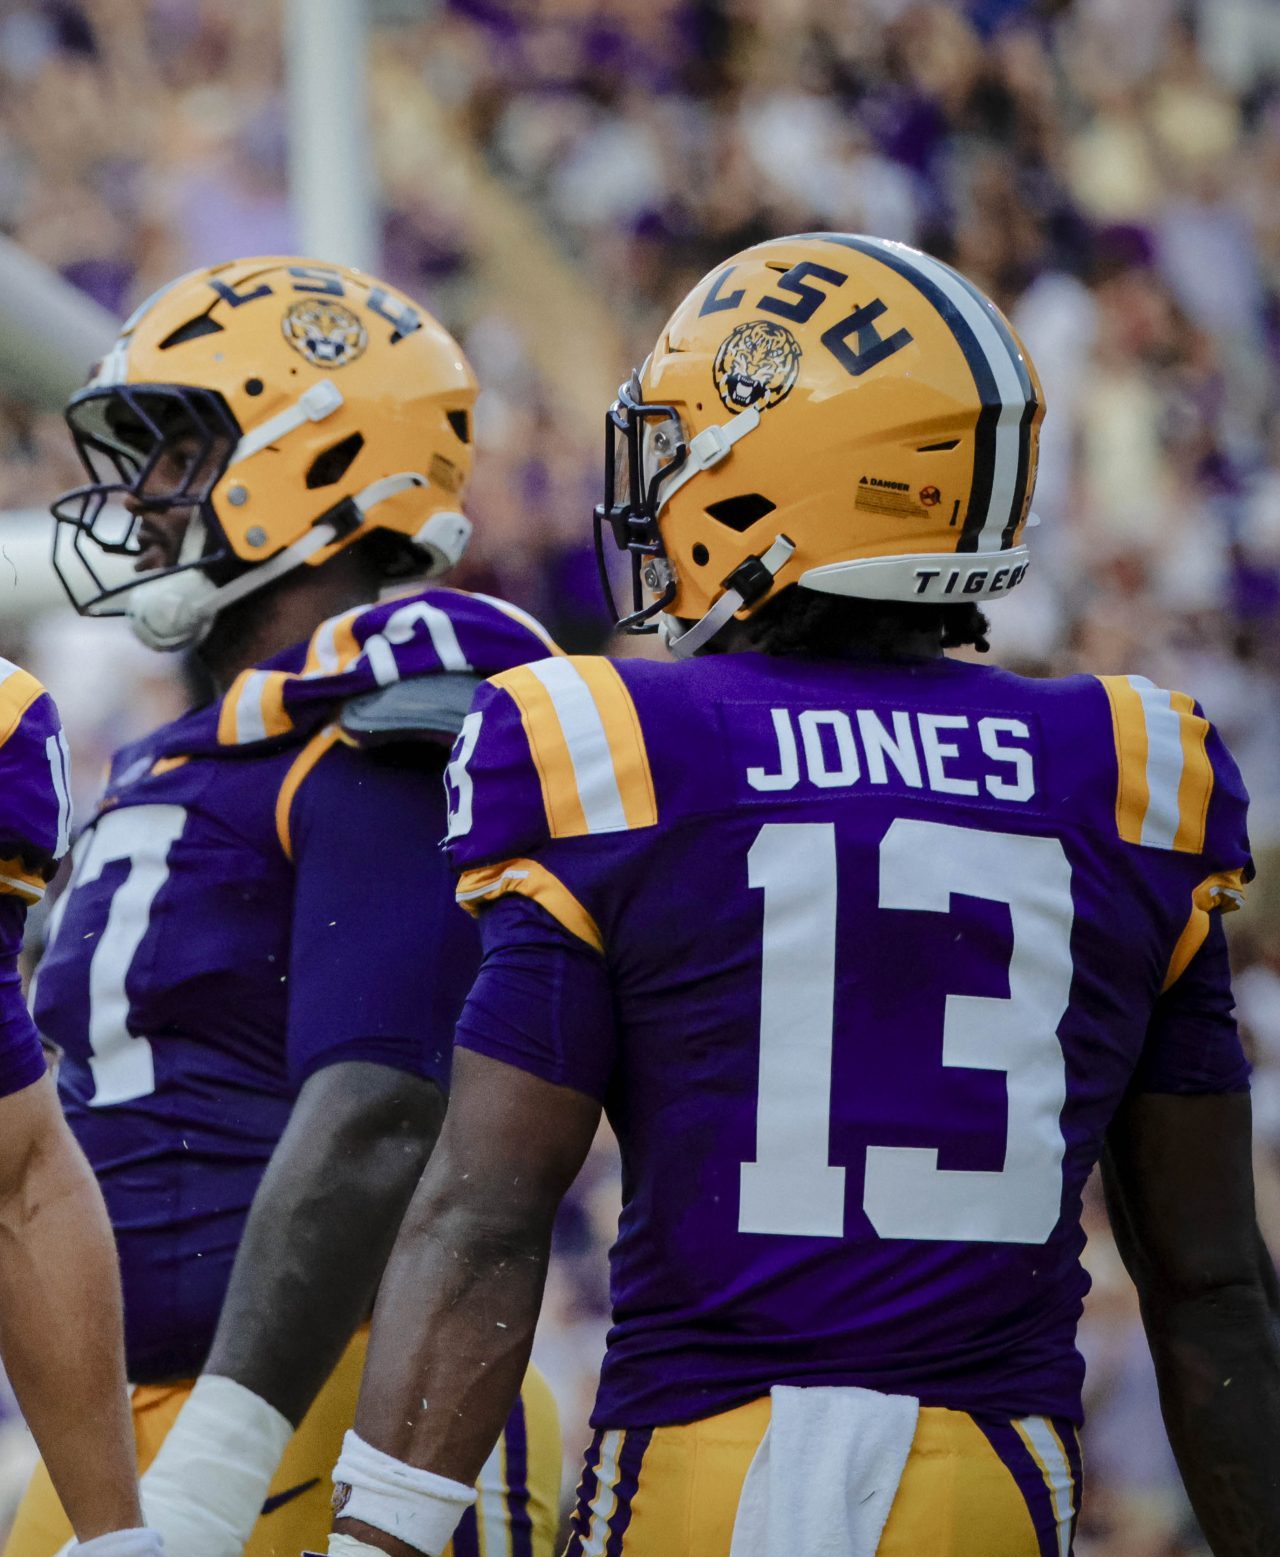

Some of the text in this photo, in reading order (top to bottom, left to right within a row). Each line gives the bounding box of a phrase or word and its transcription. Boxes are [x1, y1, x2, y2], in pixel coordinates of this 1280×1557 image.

[870, 478, 910, 492] DANGER
[746, 707, 1035, 802] JONES
[738, 818, 1074, 1245] 13
